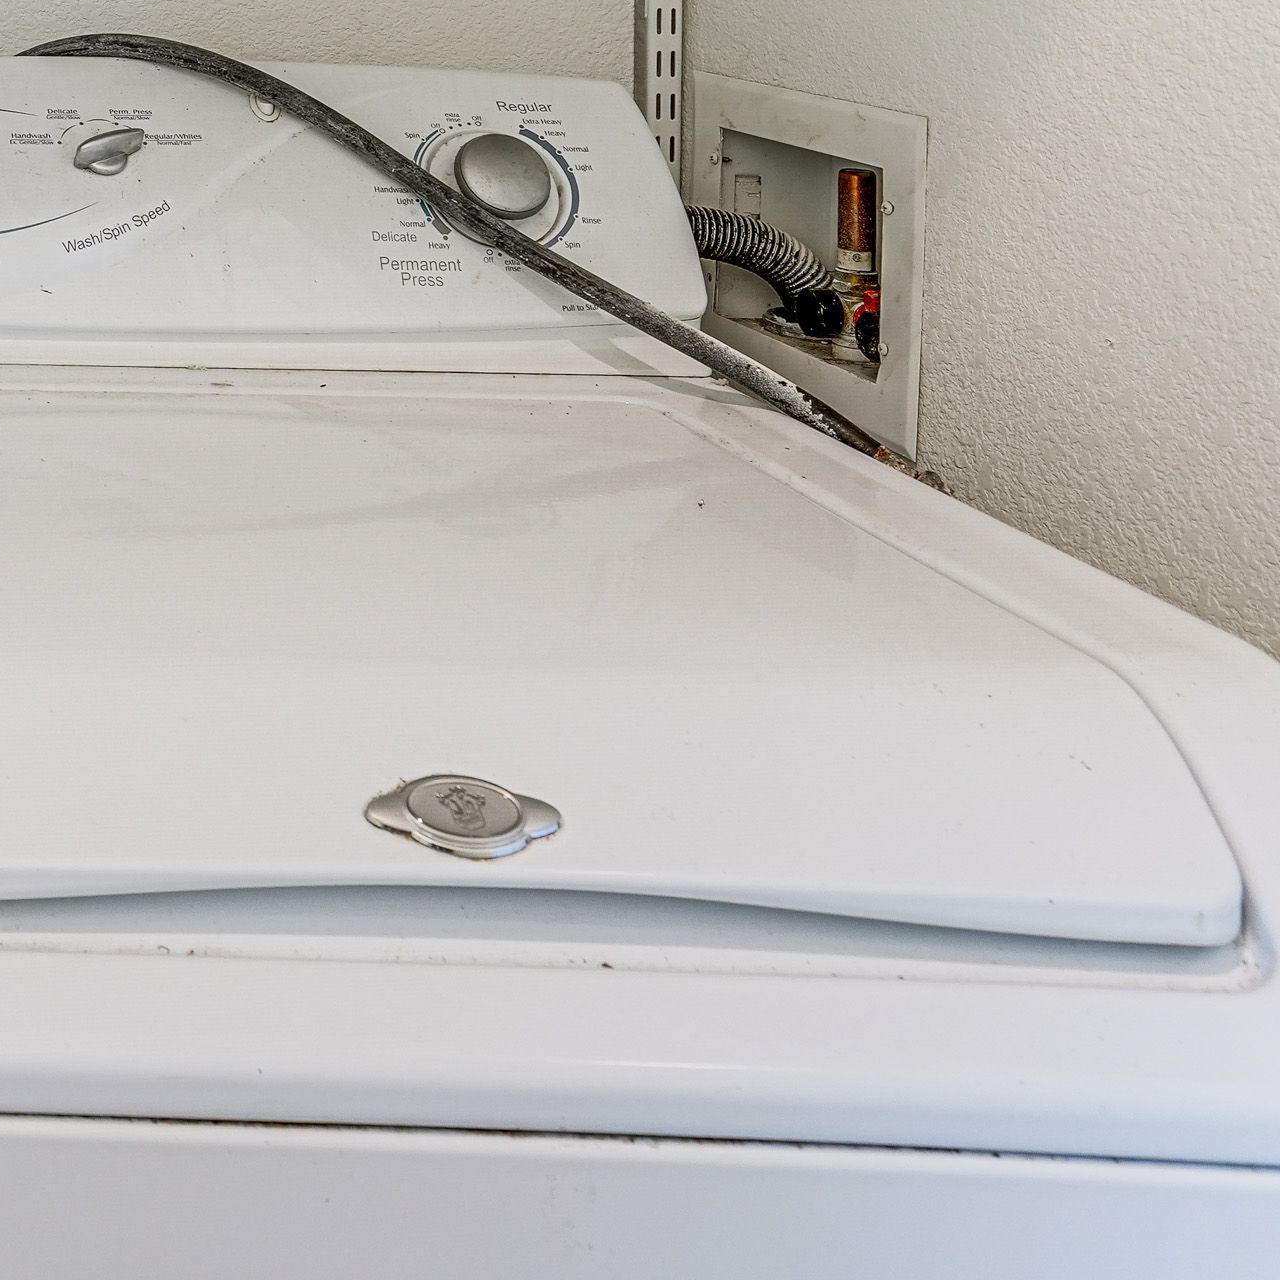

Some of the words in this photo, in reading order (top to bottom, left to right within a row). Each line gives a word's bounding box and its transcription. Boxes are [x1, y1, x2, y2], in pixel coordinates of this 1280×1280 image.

[496, 100, 552, 115] Regular
[541, 118, 562, 126] Heavy
[144, 133, 202, 141] Regular/Whites
[404, 131, 421, 139] Spin
[544, 130, 566, 138] Heavy
[562, 145, 589, 153] Normal
[574, 164, 593, 172] Light
[396, 197, 414, 206] Light
[399, 220, 426, 228] Normal
[581, 216, 602, 225] Rinse
[61, 222, 132, 254] Wash/Spin
[131, 199, 172, 228] Speed
[371, 230, 417, 243] Delicate
[428, 241, 451, 250] Heavy
[564, 241, 581, 249] Spin
[379, 256, 463, 272] Permanent
[401, 271, 444, 287] Press
[562, 304, 576, 312] Pull
[576, 304, 585, 312] to
